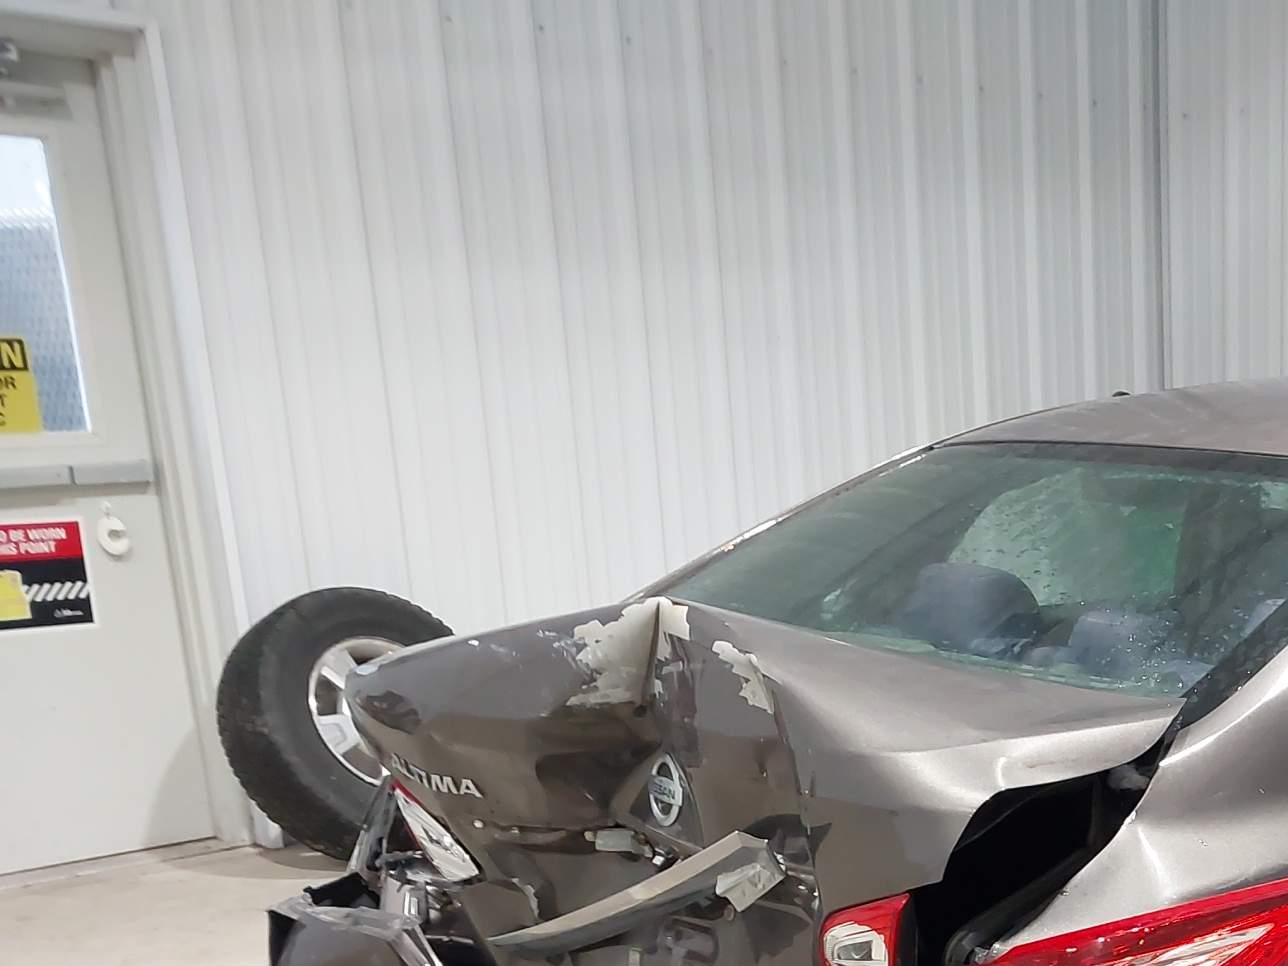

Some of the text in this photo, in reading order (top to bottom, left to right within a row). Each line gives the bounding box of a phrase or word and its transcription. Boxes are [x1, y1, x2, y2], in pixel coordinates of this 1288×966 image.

[8, 529, 26, 542] BE
[26, 527, 67, 540] WORN
[19, 540, 56, 554] POINT
[391, 752, 484, 798] ALTIMA
